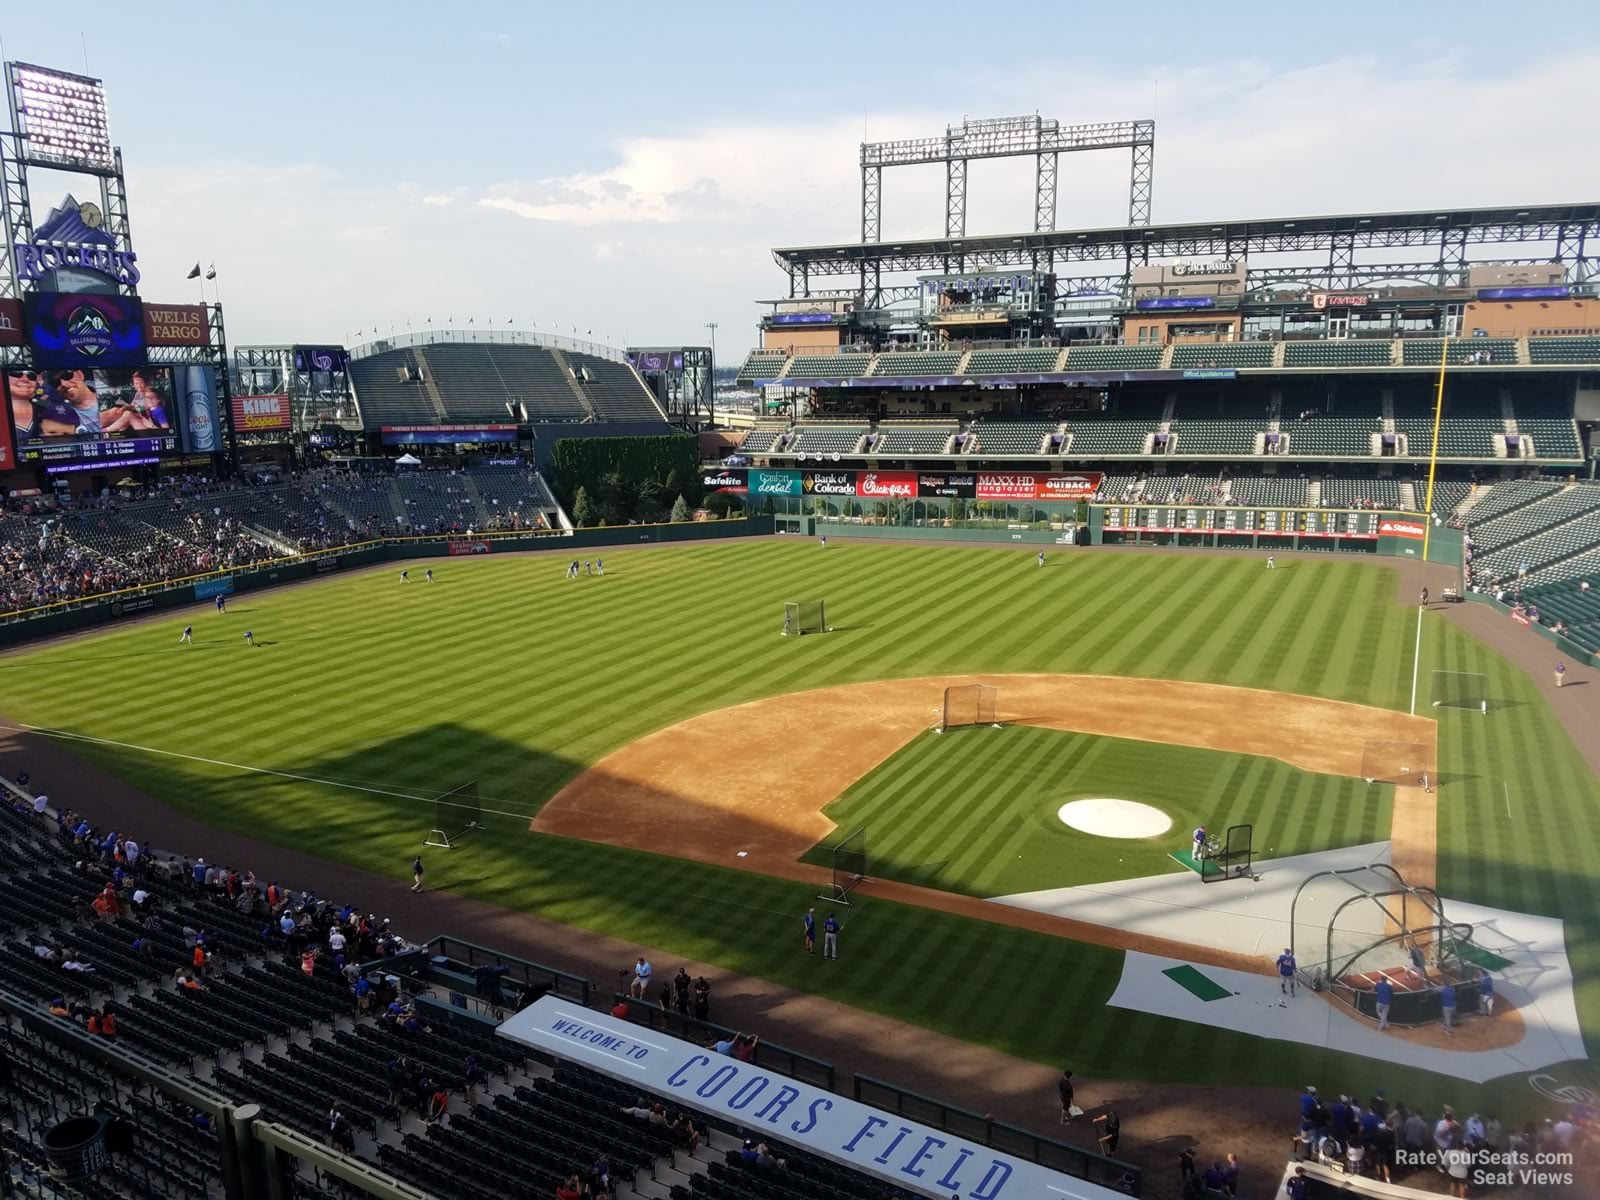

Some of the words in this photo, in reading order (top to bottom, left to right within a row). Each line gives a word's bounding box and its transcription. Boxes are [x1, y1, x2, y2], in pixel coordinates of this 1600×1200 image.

[14, 244, 140, 286] ROCKIES
[918, 280, 945, 294] THE
[1329, 296, 1368, 304] TAVERN
[149, 311, 200, 324] WELLS
[152, 326, 200, 339] FARGO
[242, 399, 280, 415] KING
[245, 415, 282, 429] Soopers
[704, 477, 741, 485] Safelite
[760, 473, 788, 482] Comfort
[815, 474, 836, 483] Bank
[839, 474, 847, 483] of
[979, 476, 1014, 486] MAXX
[1016, 476, 1034, 486] HD
[758, 480, 791, 493] dental
[815, 483, 855, 494] Colorado
[552, 1019, 629, 1053] WELCOME
[627, 1042, 649, 1061] TO
[667, 1055, 833, 1135] COORS
[841, 1115, 1013, 1200] FIELD
